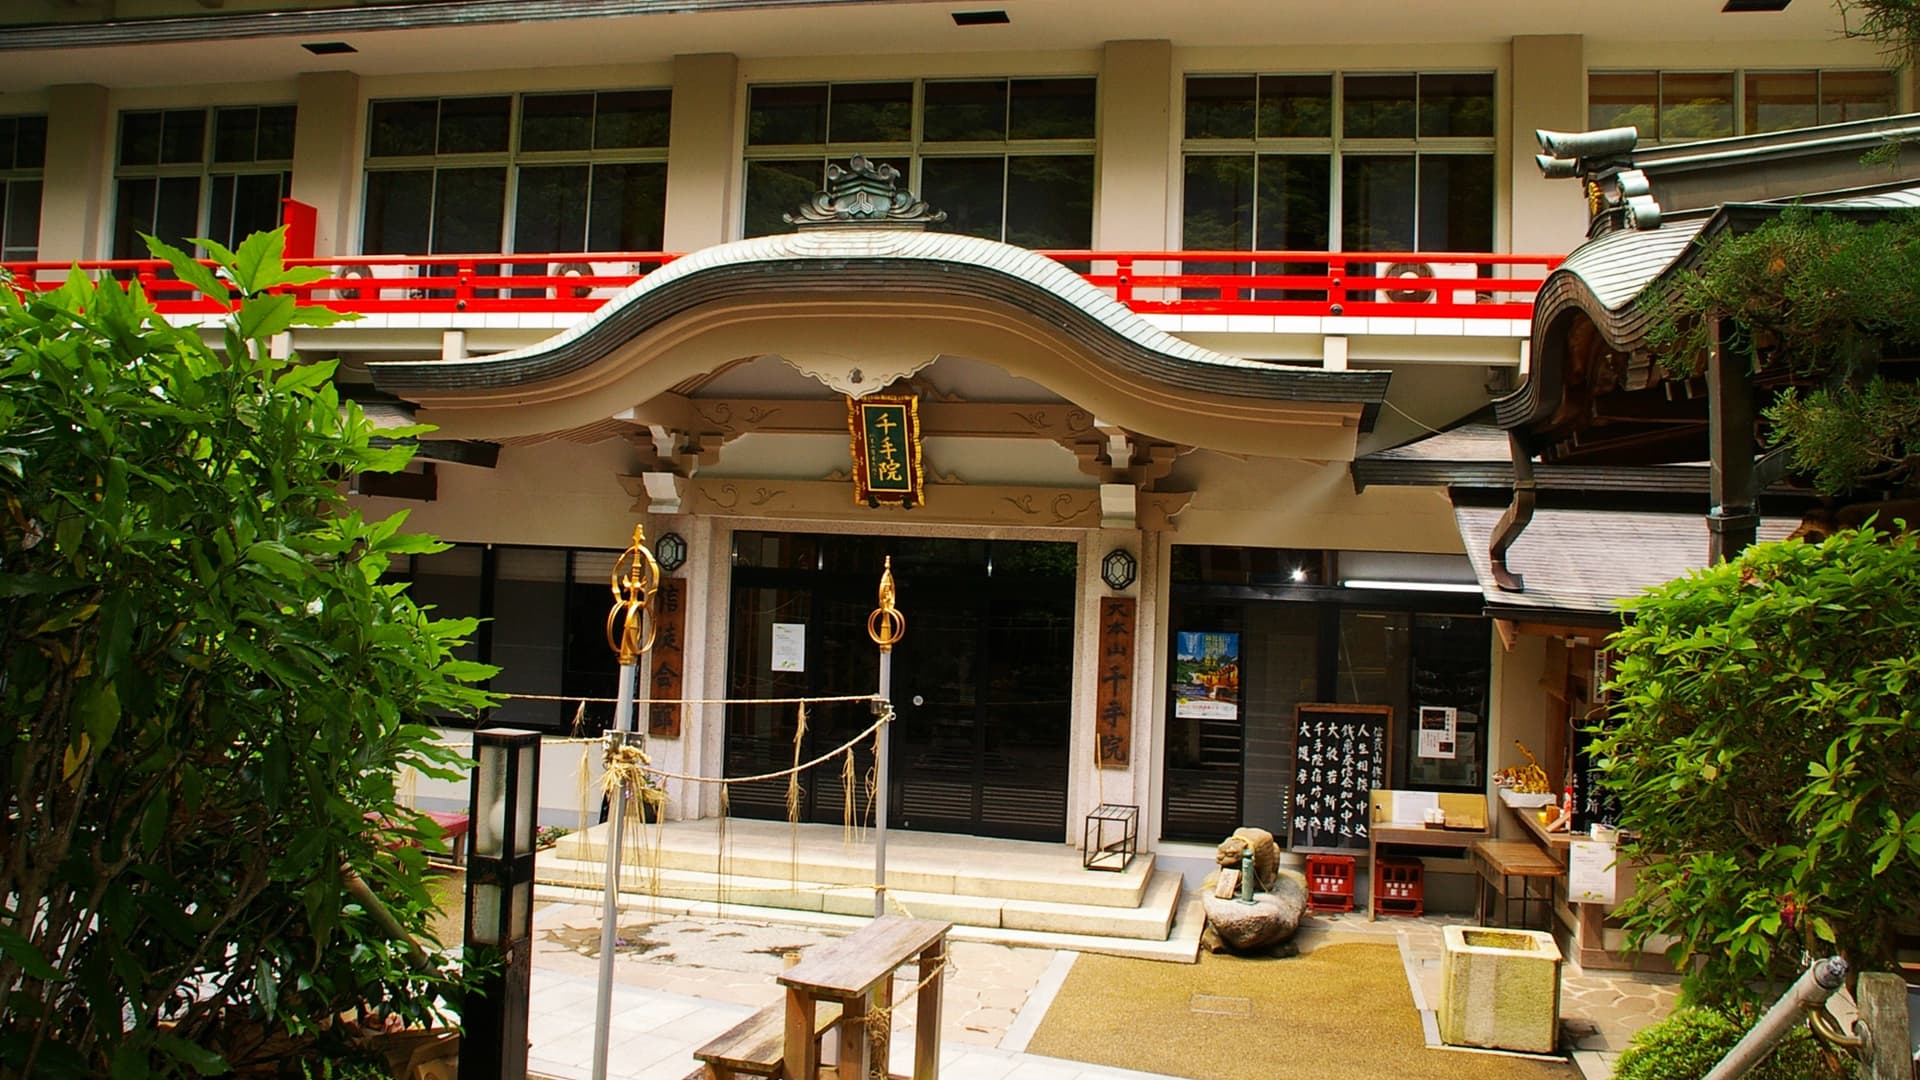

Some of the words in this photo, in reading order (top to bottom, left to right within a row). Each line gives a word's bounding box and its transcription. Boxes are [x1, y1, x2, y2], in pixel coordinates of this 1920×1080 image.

[875, 412, 902, 481] 千手院
[1102, 603, 1128, 761] 大本山千手院
